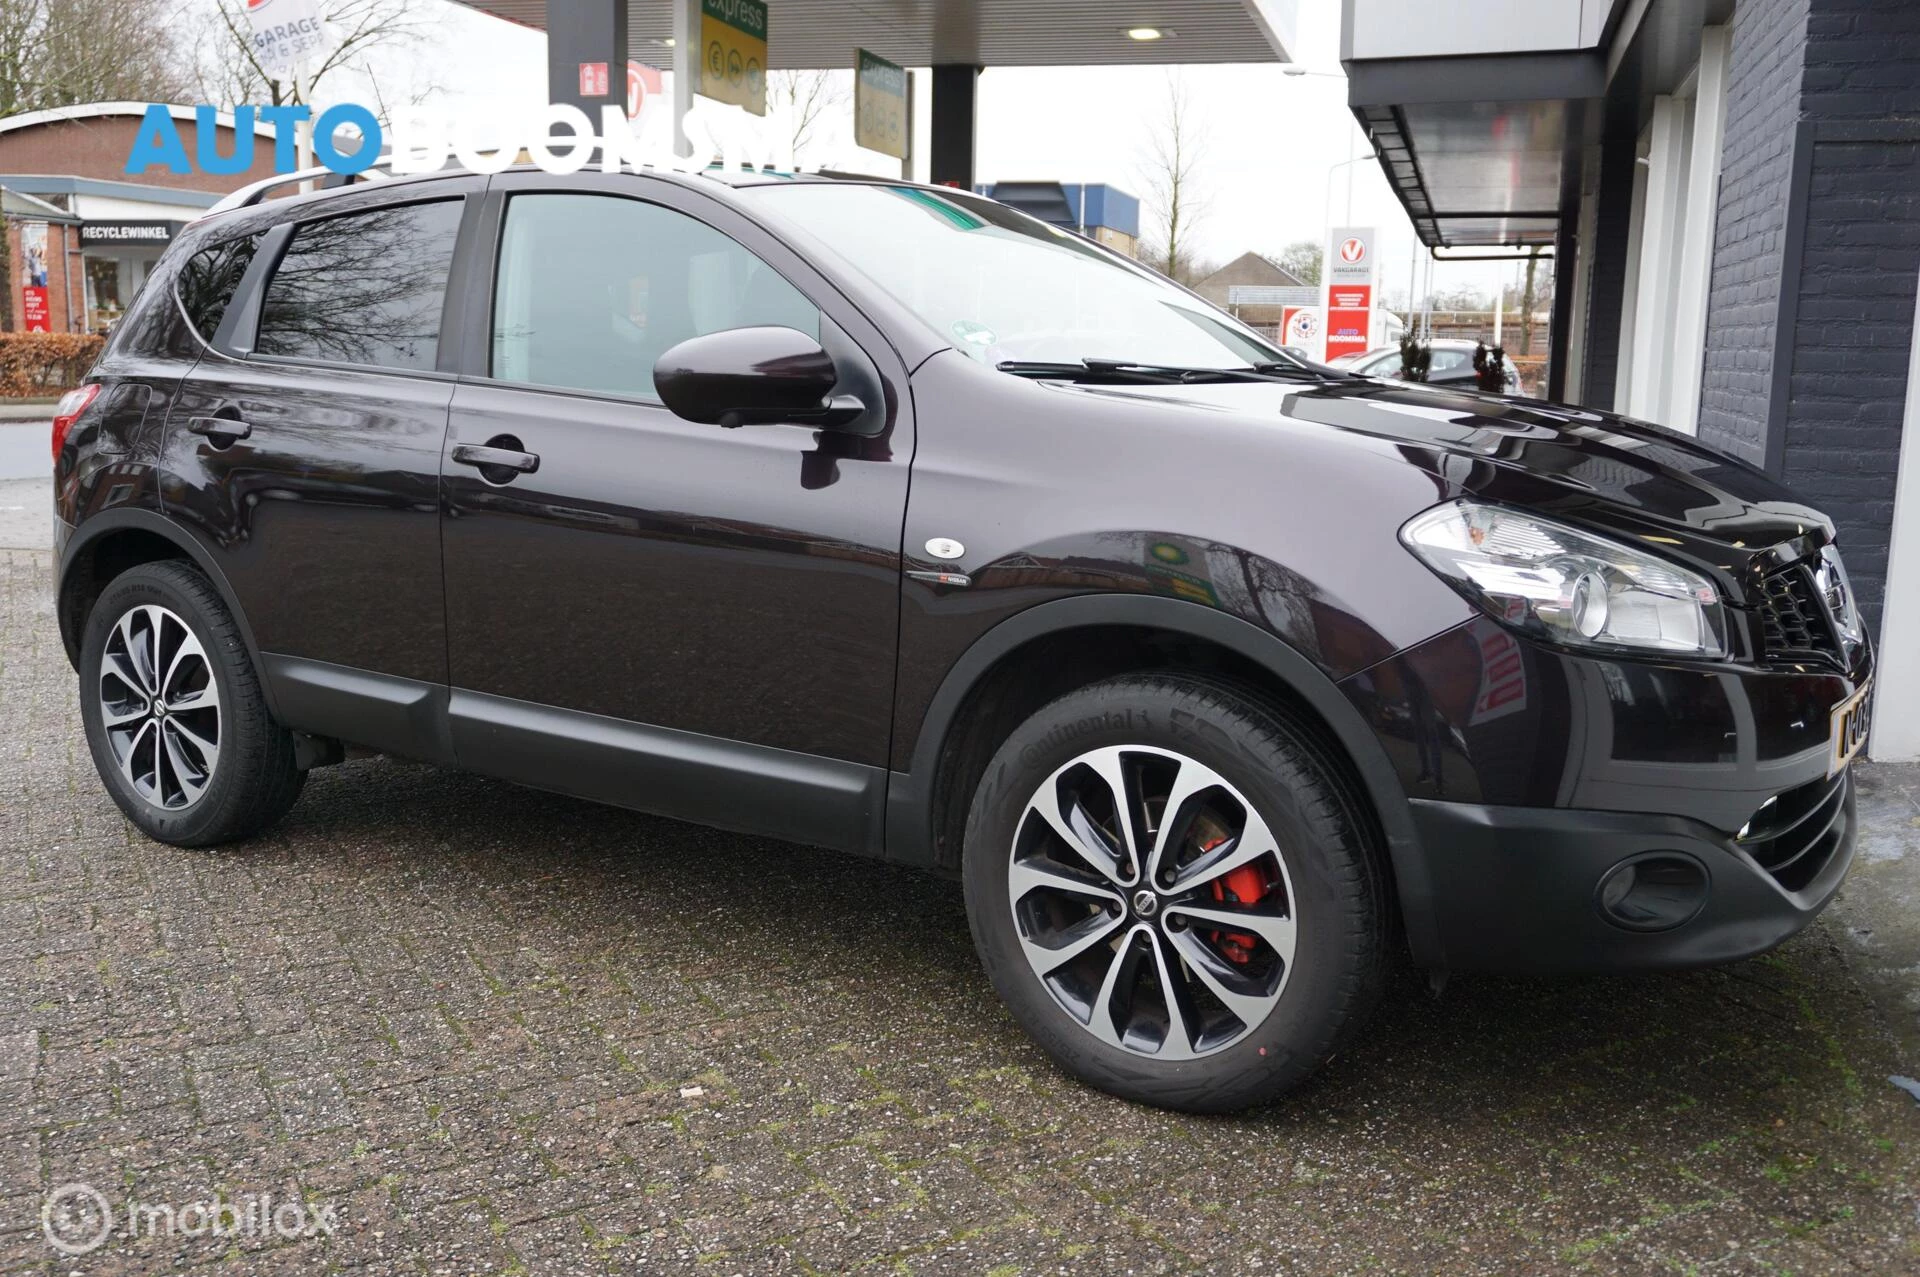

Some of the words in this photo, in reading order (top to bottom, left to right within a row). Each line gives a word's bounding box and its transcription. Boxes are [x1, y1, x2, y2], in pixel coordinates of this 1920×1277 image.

[254, 17, 320, 48] GARAGE
[82, 226, 170, 239] RECYCLEWINKEL
[1021, 708, 1133, 768] Continental
